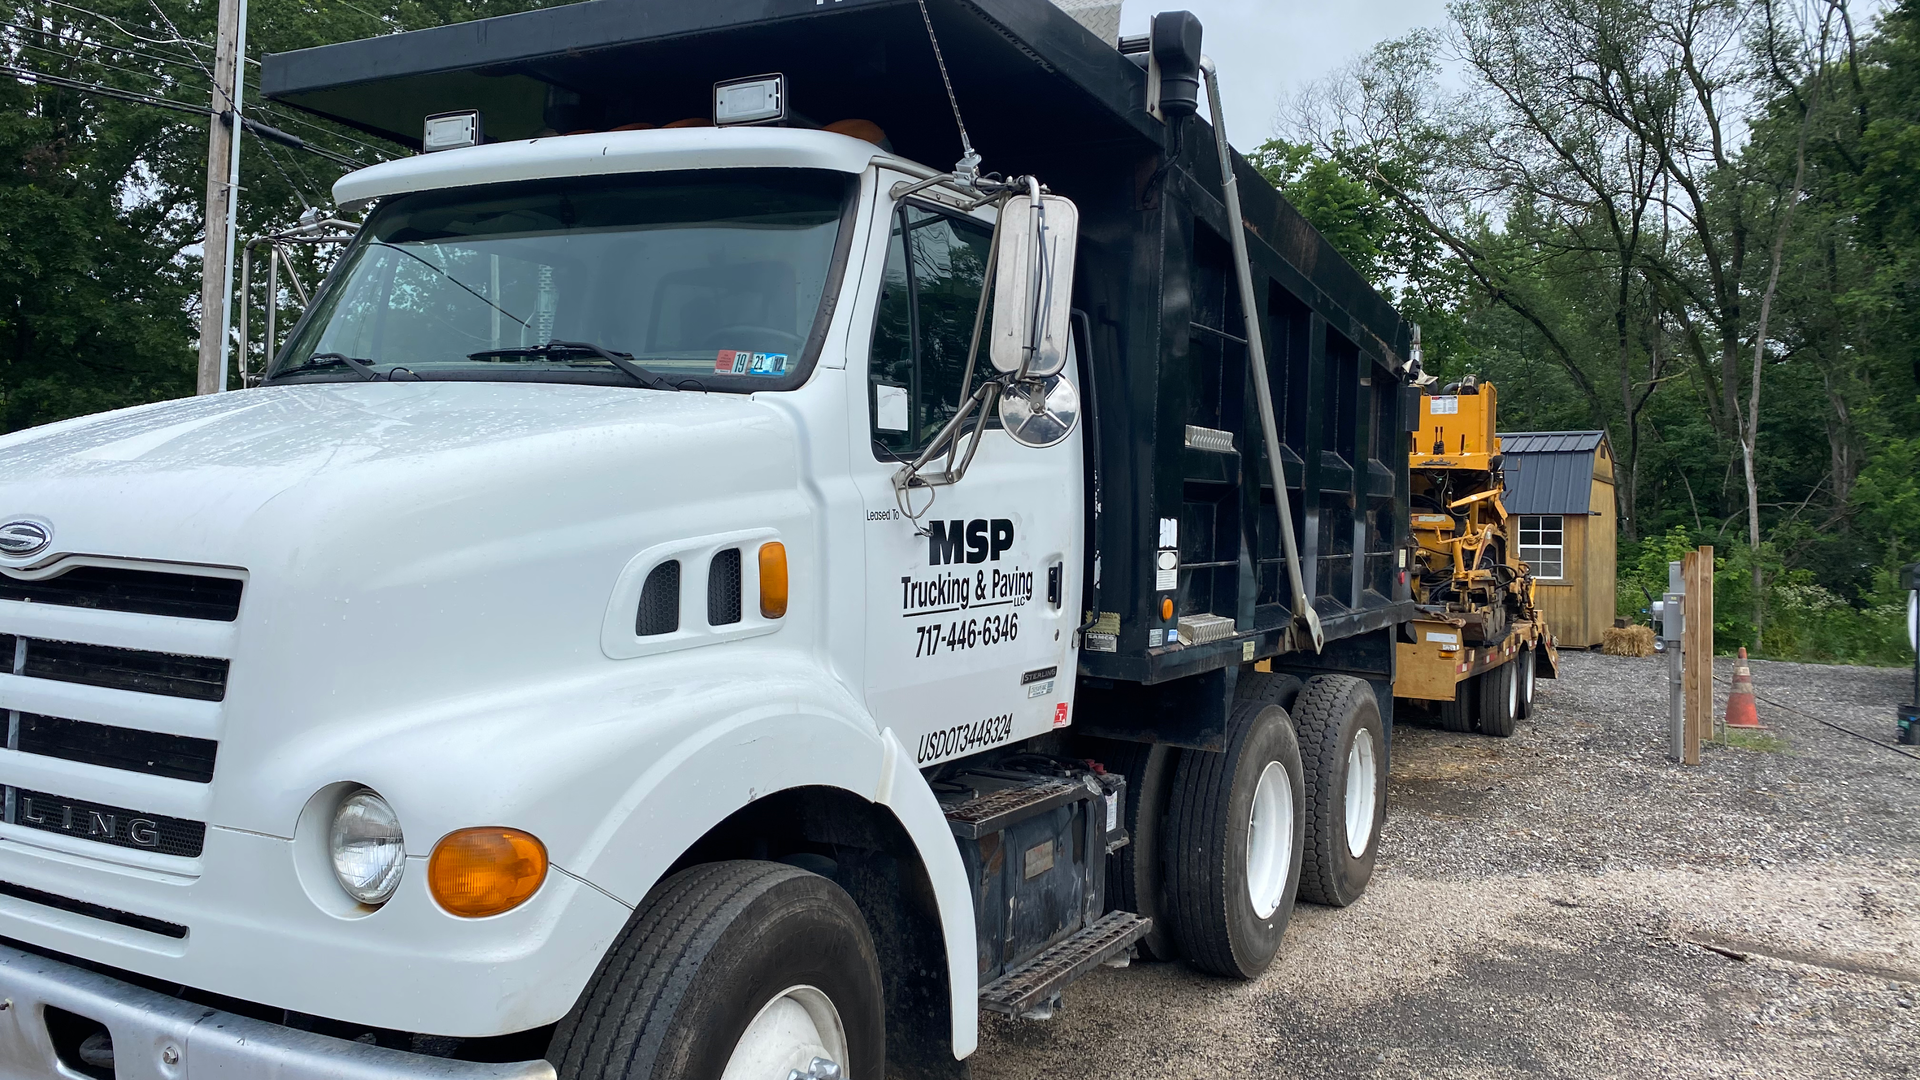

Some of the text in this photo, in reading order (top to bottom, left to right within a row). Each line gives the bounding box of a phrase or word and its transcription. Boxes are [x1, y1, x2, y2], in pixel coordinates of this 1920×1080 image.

[734, 353, 747, 373] 19
[753, 355, 765, 370] 21
[866, 508, 900, 521] Leased To
[928, 518, 1015, 566] MSP
[901, 566, 1034, 610] Trucking & Paving
[1013, 596, 1027, 608] LLC
[916, 612, 1019, 659] 717-446-6346
[1024, 668, 1057, 682] STERLING
[917, 712, 1014, 764] USDOT3448324
